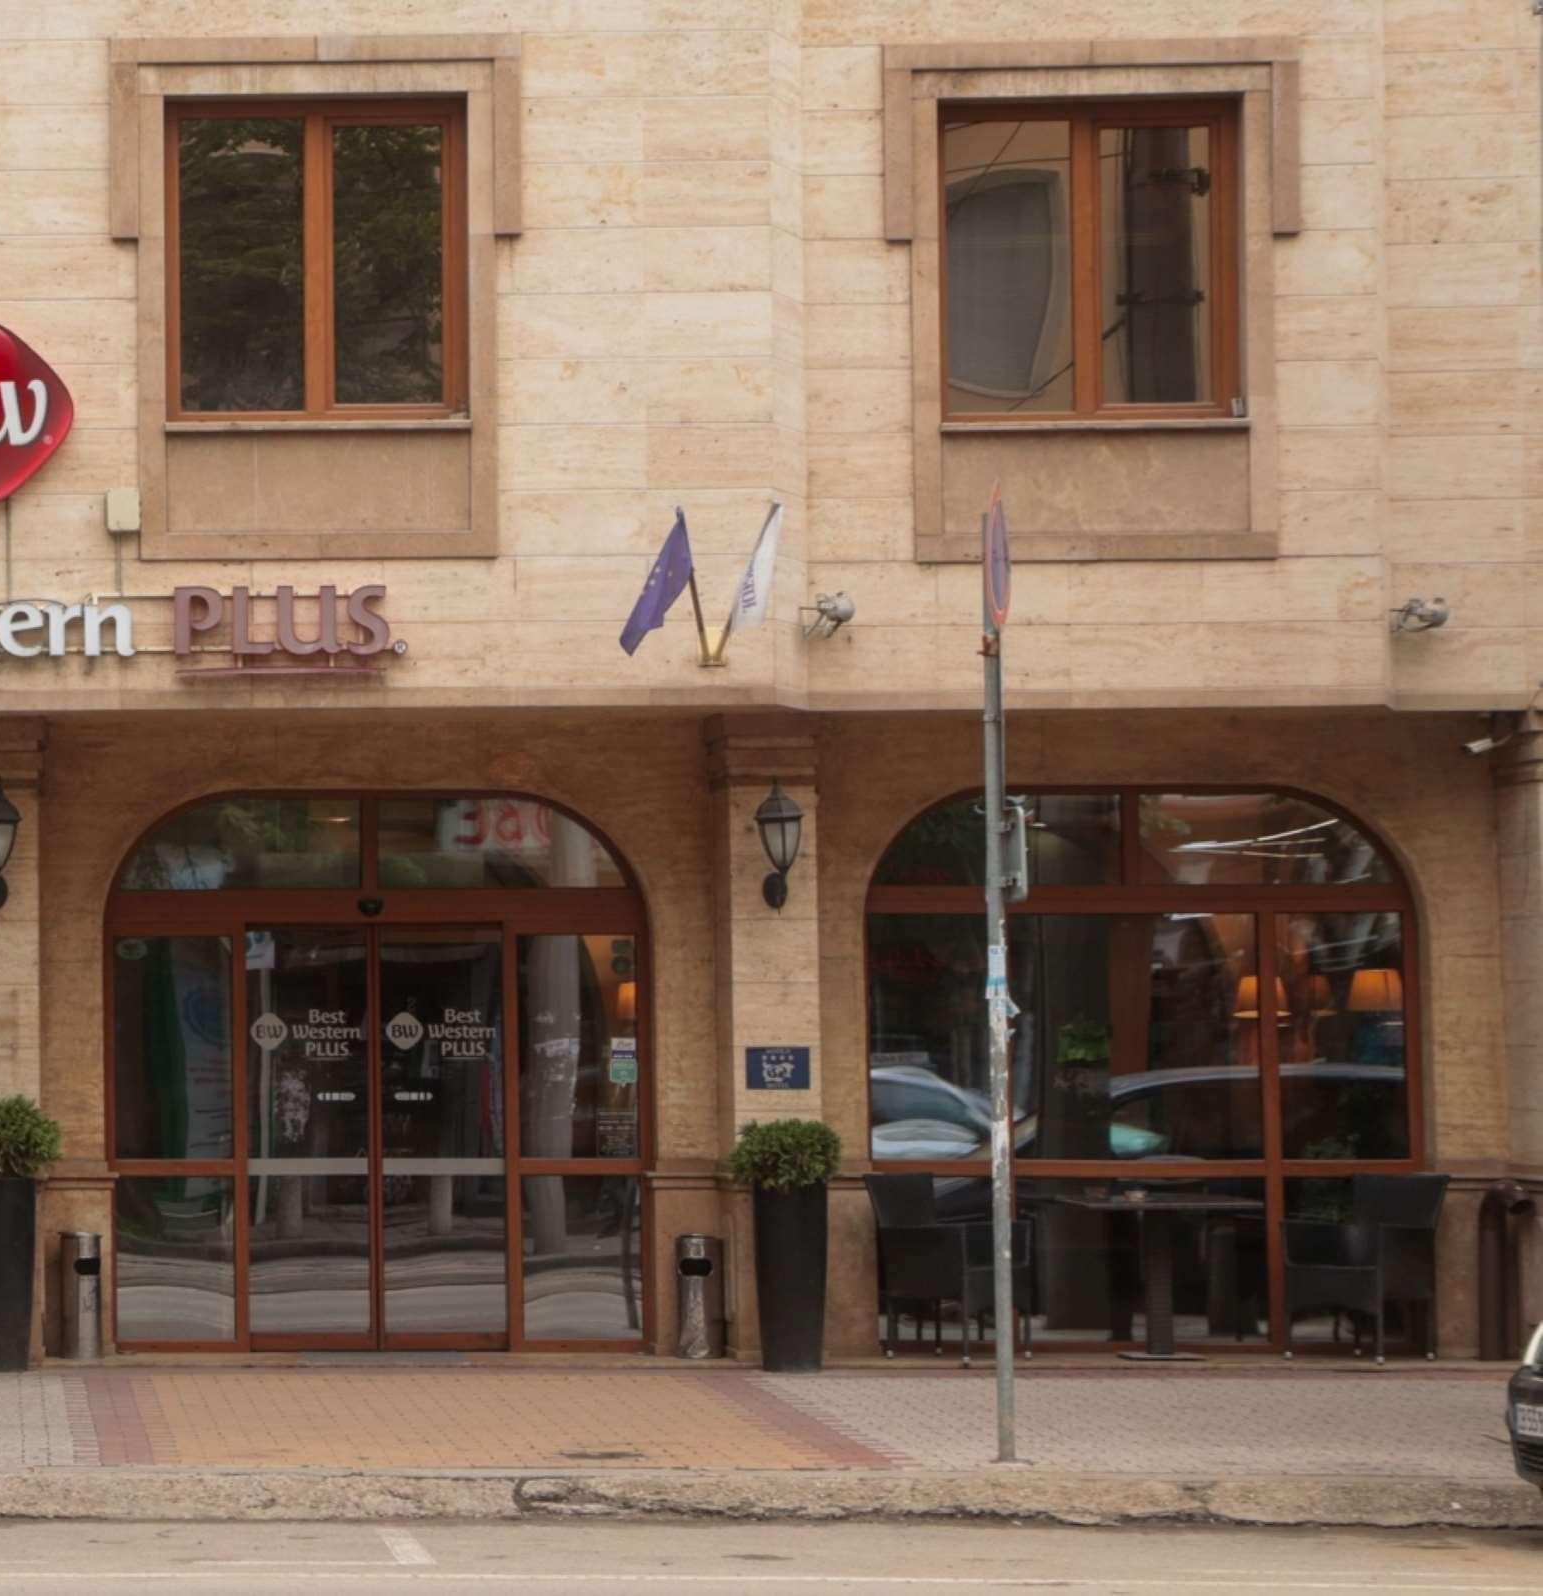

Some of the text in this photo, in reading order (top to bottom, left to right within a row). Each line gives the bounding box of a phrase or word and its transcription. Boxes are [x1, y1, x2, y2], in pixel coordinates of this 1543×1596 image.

[308, 1008, 346, 1024] Best
[444, 1008, 482, 1024] Best
[292, 1024, 361, 1040] Western
[391, 1023, 419, 1040] BW
[428, 1023, 496, 1040] Western
